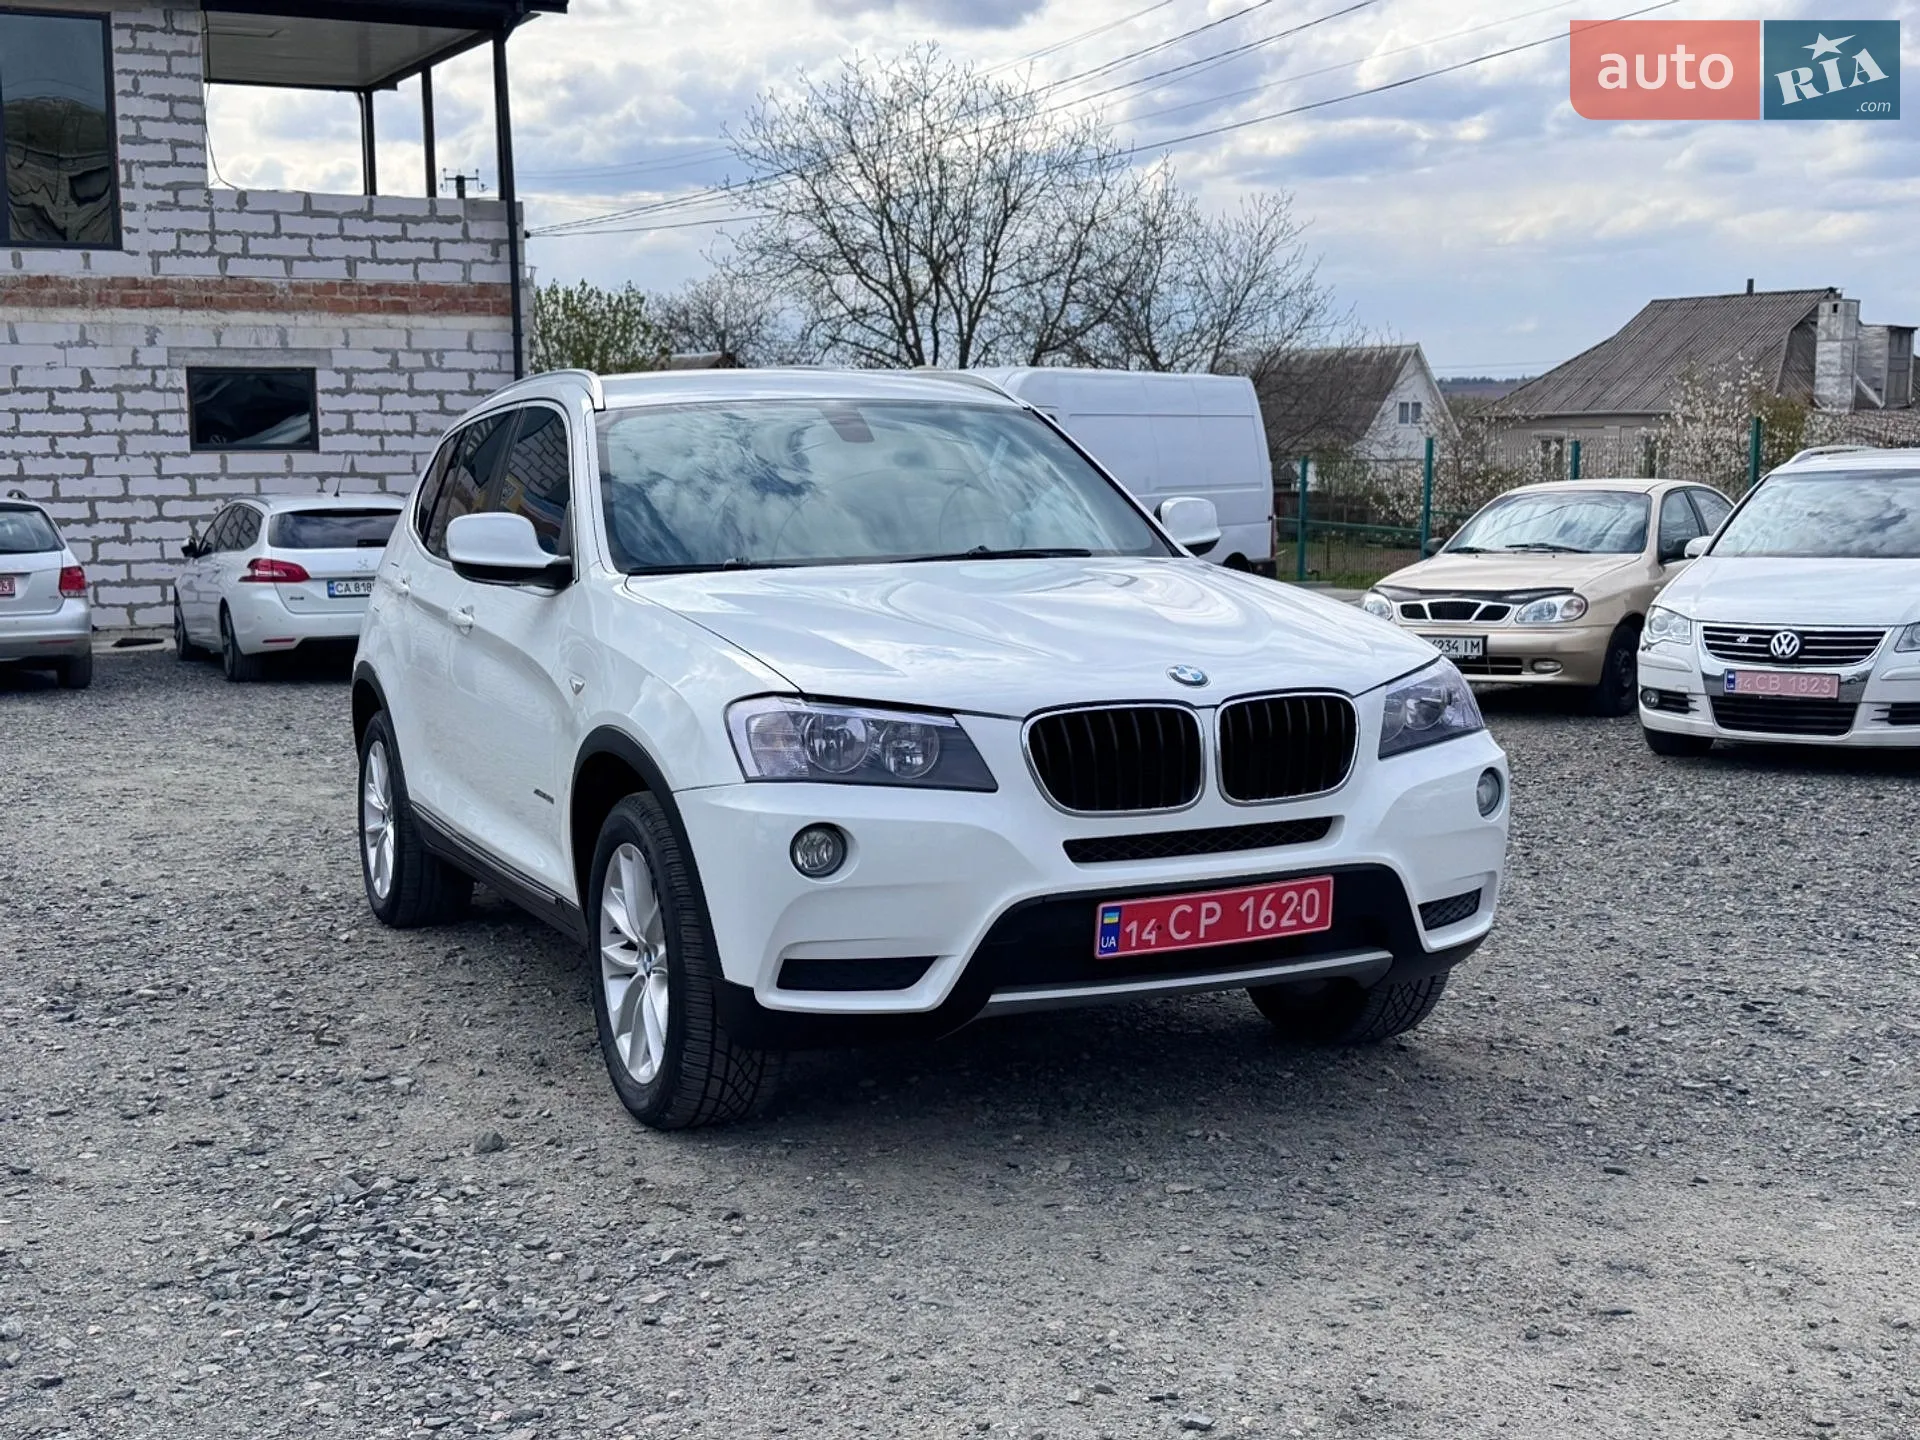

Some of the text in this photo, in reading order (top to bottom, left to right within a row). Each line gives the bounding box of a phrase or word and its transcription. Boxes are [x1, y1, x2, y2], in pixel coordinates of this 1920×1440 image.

[335, 582, 352, 593] CA
[1464, 640, 1480, 653] IM
[1755, 674, 1781, 691] CB
[1788, 676, 1832, 693] 1823
[1125, 888, 1321, 947] 14 CP 1620
[1101, 934, 1117, 948] UA
